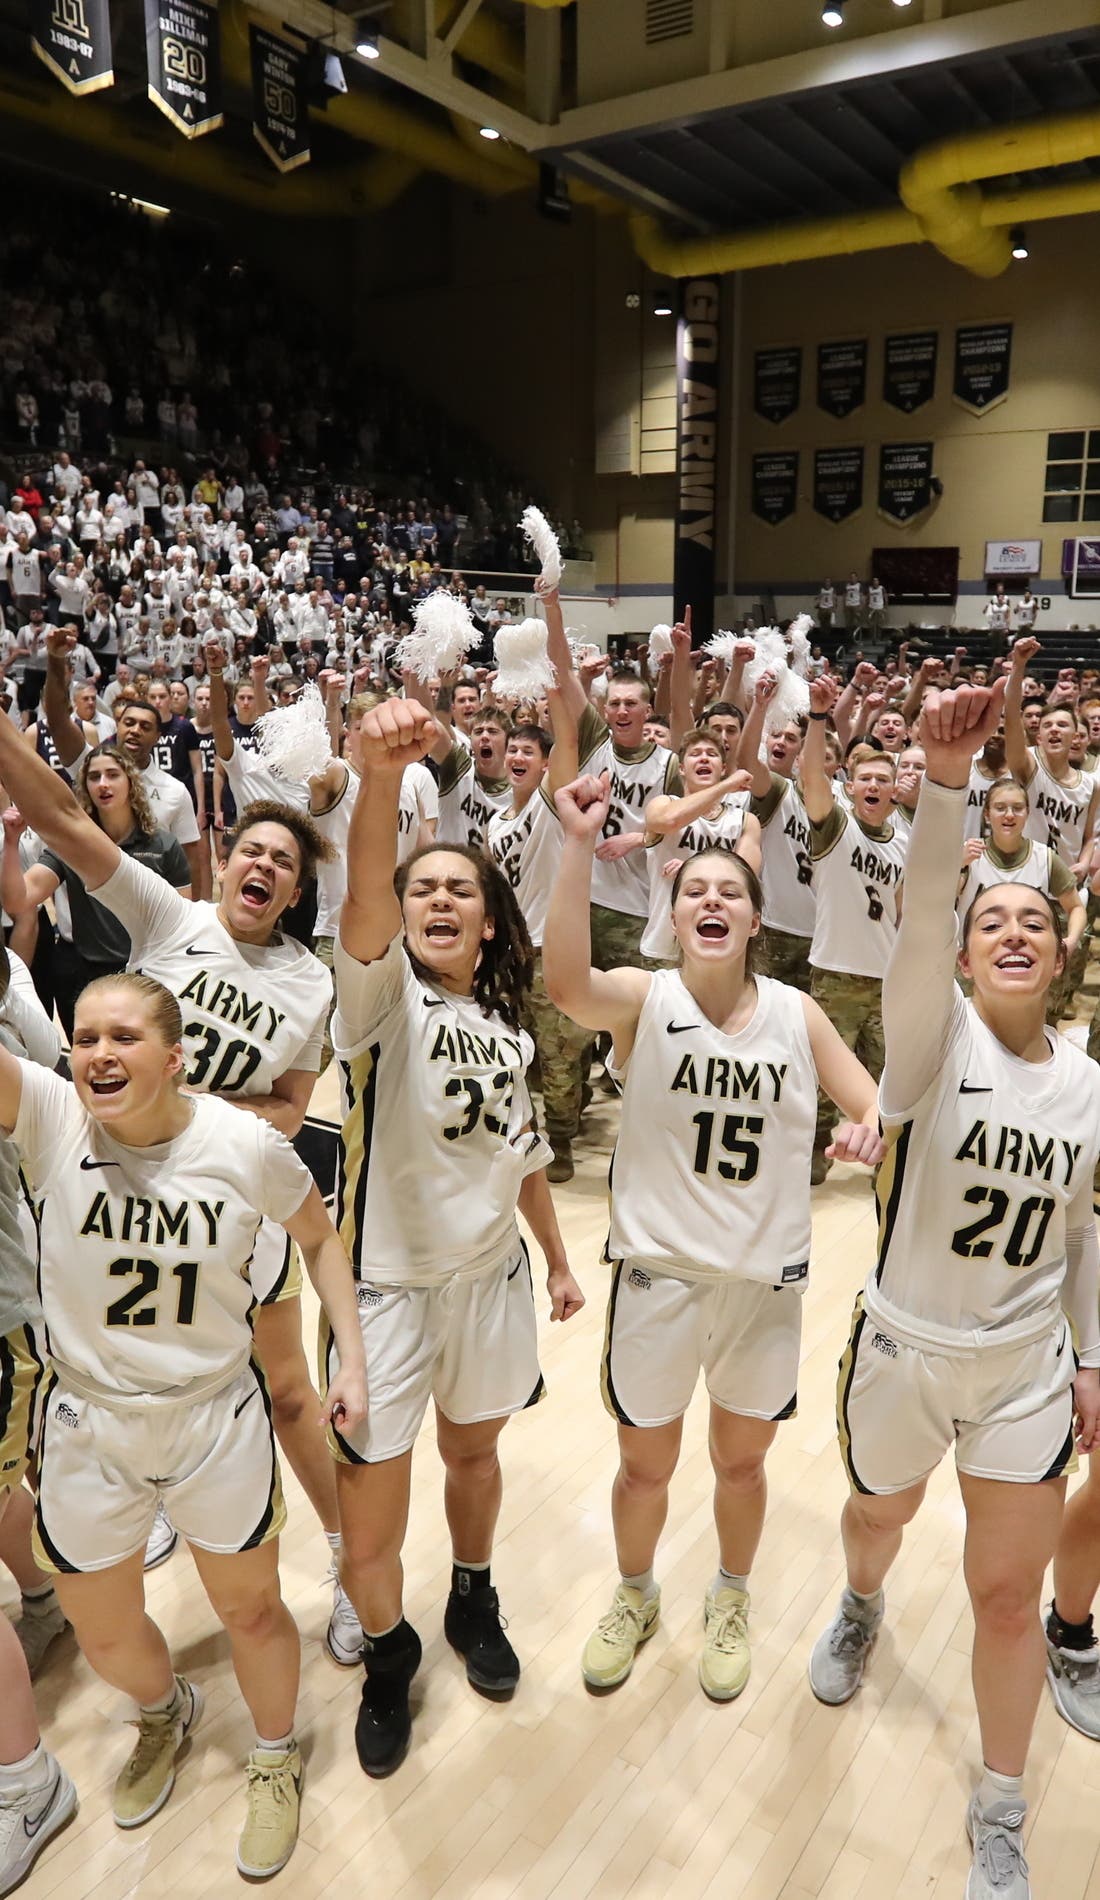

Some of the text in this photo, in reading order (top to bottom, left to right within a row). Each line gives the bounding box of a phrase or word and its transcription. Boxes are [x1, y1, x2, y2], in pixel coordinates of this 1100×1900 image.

[159, 17, 208, 47] SILLIMAN
[169, 8, 196, 30] MIKE
[163, 36, 207, 84] 20
[264, 77, 296, 123] 50
[680, 280, 719, 550] GO ARMY
[24, 566, 30, 577] 6
[164, 652, 170, 662] 6
[153, 746, 172, 770] 13
[157, 735, 178, 744] AVY
[150, 788, 160, 800] A
[460, 793, 496, 826] ARM
[967, 790, 988, 807] AR
[1036, 792, 1084, 826] ARMY
[602, 804, 625, 840] 6
[784, 814, 810, 850] AR
[850, 846, 902, 888] ARMY
[178, 970, 287, 1044] ARMY
[181, 1021, 262, 1092] 30
[427, 1023, 523, 1069] ARMY
[669, 1052, 790, 1104] ARMY
[440, 1070, 514, 1142] 33
[691, 1110, 765, 1185] 15
[953, 1118, 1085, 1188] ARMY
[79, 1190, 227, 1248] ARMY
[950, 1184, 1058, 1268] 20
[104, 1255, 202, 1329] 21
